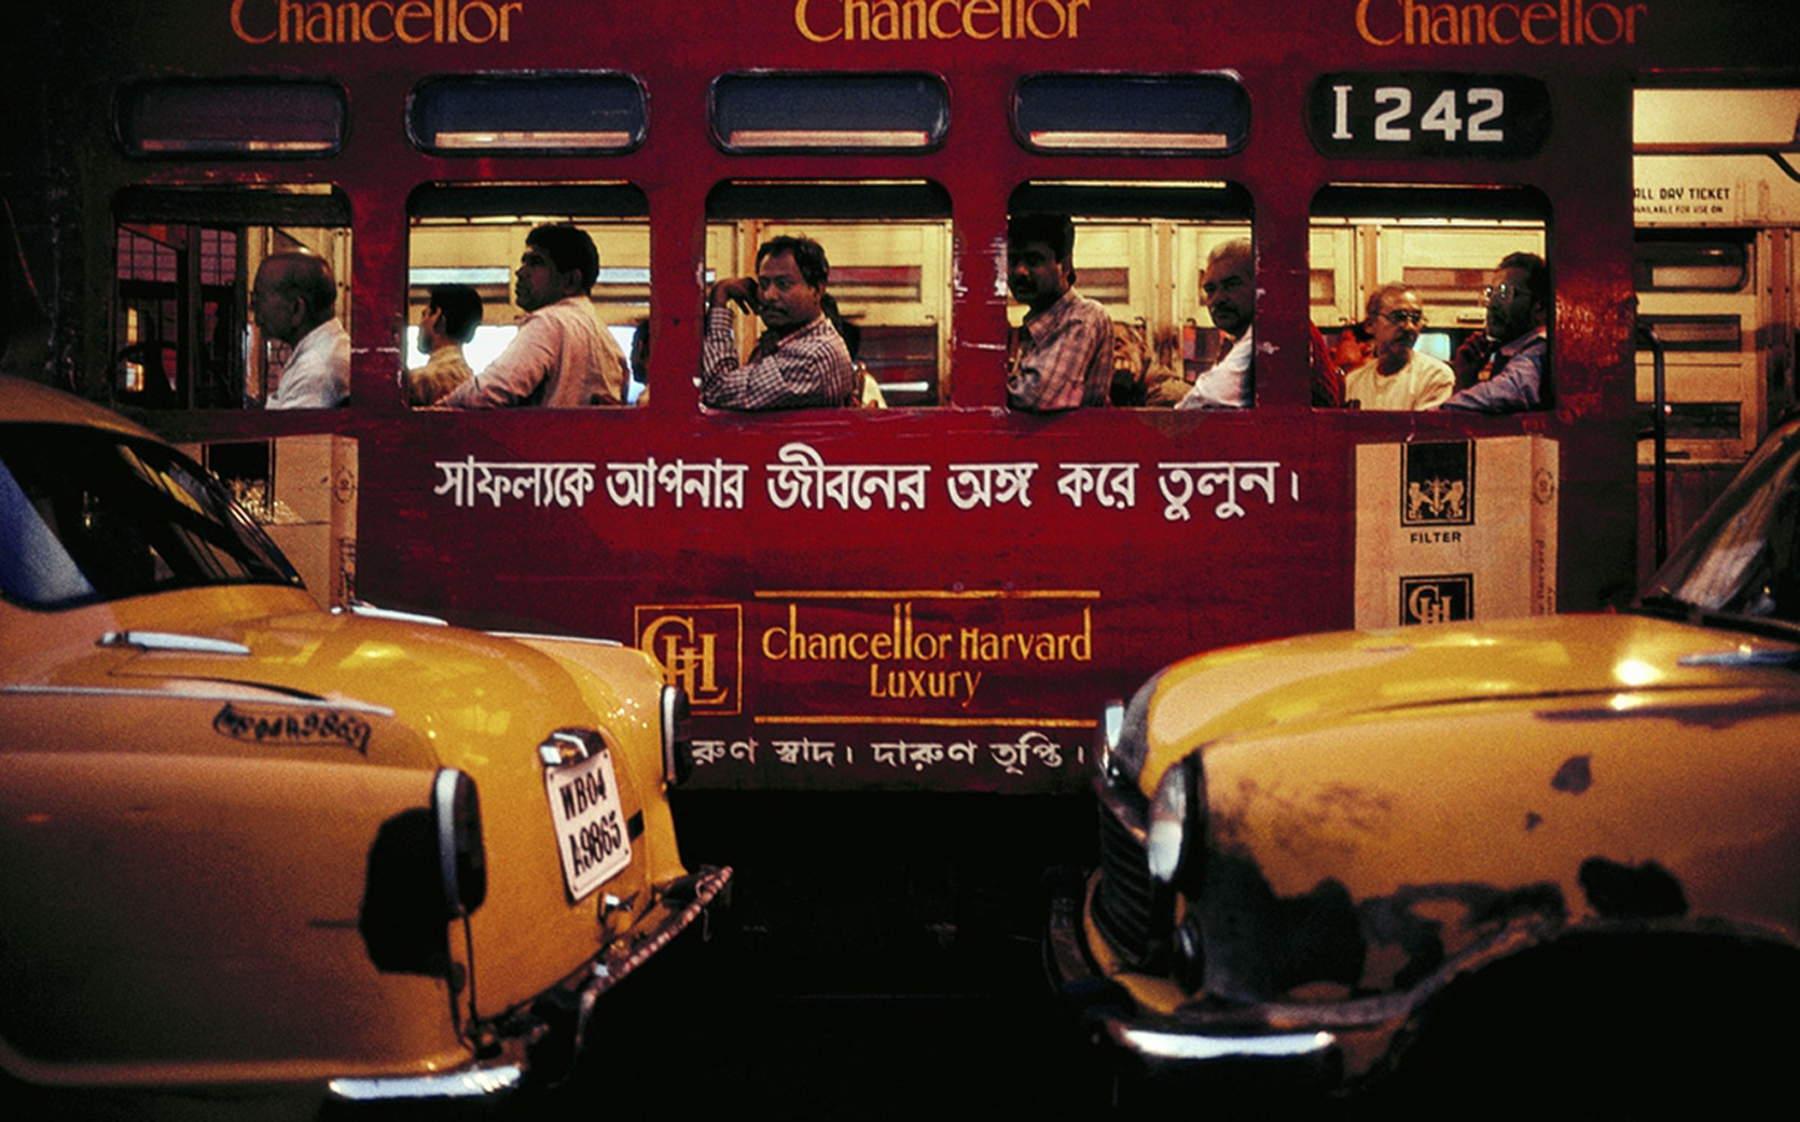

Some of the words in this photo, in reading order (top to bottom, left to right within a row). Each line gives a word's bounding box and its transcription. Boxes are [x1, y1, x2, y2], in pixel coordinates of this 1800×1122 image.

[230, 0, 523, 44] Chancellor
[794, 0, 1092, 42] Chancellor
[1355, 0, 1649, 46] Chancellor
[1374, 86, 1505, 142] 242
[1633, 187, 1653, 201] ALL
[1659, 187, 1684, 201] DAY
[1689, 187, 1730, 201] TICKET
[434, 455, 596, 507] সাফল্যকে
[606, 457, 749, 509] আপনার
[766, 442, 931, 510] জীবনের
[947, 463, 1039, 509] অঙ্গ
[1057, 463, 1140, 509] করে
[1410, 531, 1462, 544] FILTER
[762, 602, 952, 661] Chancellor
[959, 605, 1093, 661] Harvard
[870, 664, 983, 708] Luxury
[690, 736, 760, 765] রুণ
[870, 739, 978, 771] দারুণ
[559, 767, 608, 821] WB04
[568, 810, 622, 877] A9865
